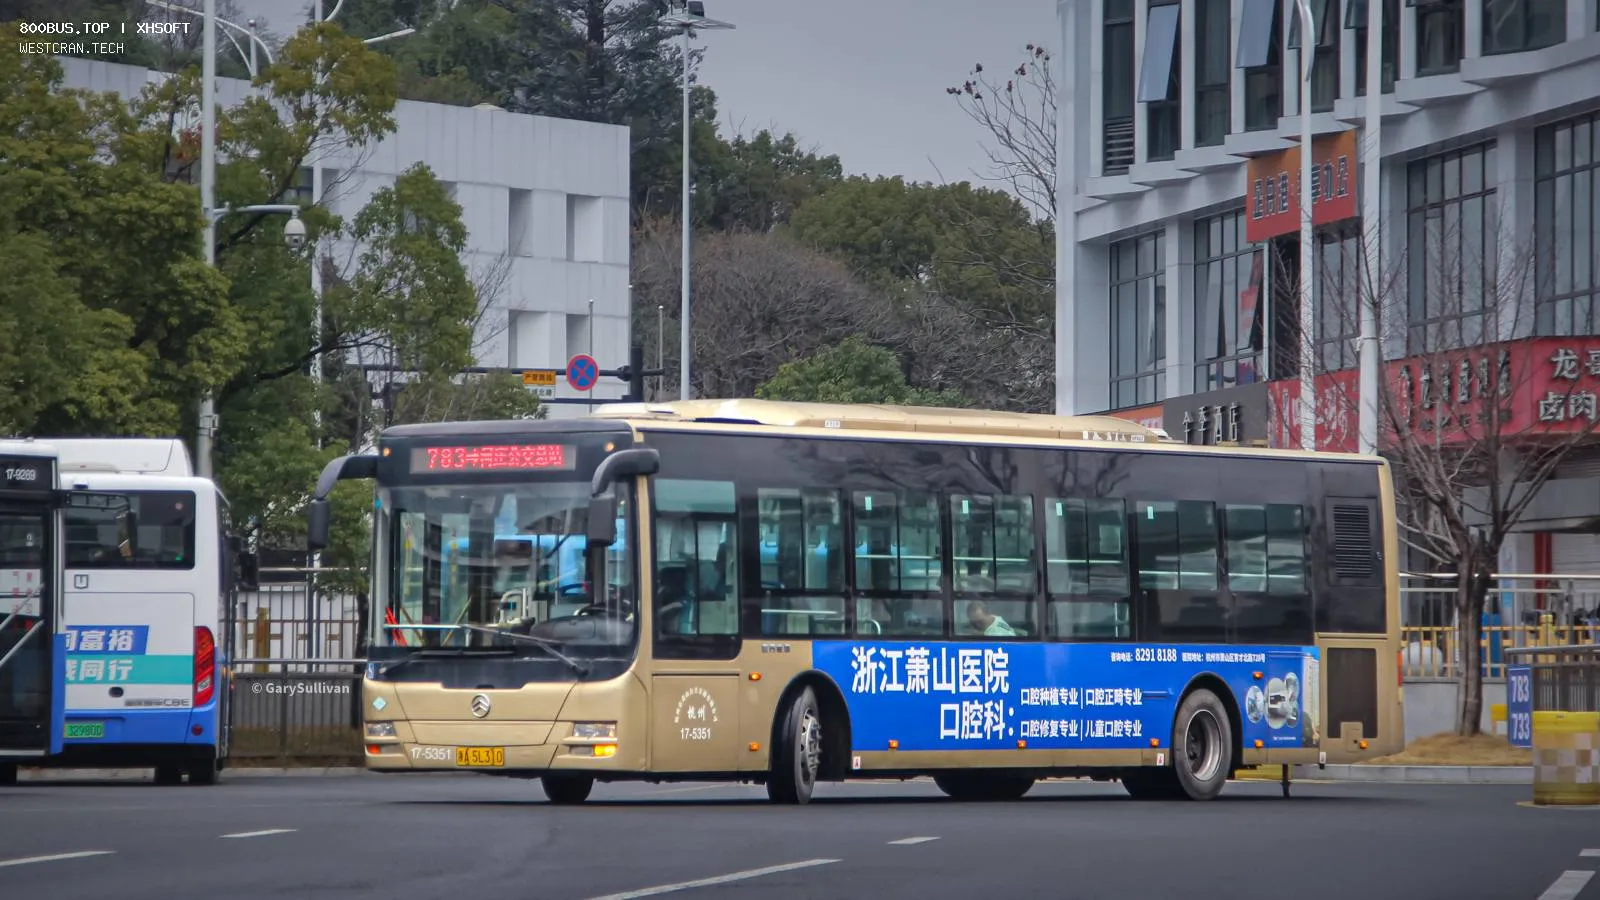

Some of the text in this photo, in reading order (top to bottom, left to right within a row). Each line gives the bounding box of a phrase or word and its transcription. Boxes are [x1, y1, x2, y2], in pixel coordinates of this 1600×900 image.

[1540, 391, 1597, 420] 卤肉
[427, 447, 465, 469] 783
[1135, 648, 1155, 662] 8291
[1157, 648, 1177, 662] 8188
[851, 647, 1010, 695] 浙江萧山医院
[1020, 688, 1079, 706] 口腔种植专业
[1085, 688, 1143, 706] 口腔正畸专业
[1511, 675, 1530, 703] 783
[680, 728, 711, 740] 17-5351
[1020, 720, 1079, 738] 口腔修复专业
[1085, 720, 1142, 738] 儿童口腔专业
[1512, 713, 1530, 740] 733
[411, 748, 451, 760] 17-5351
